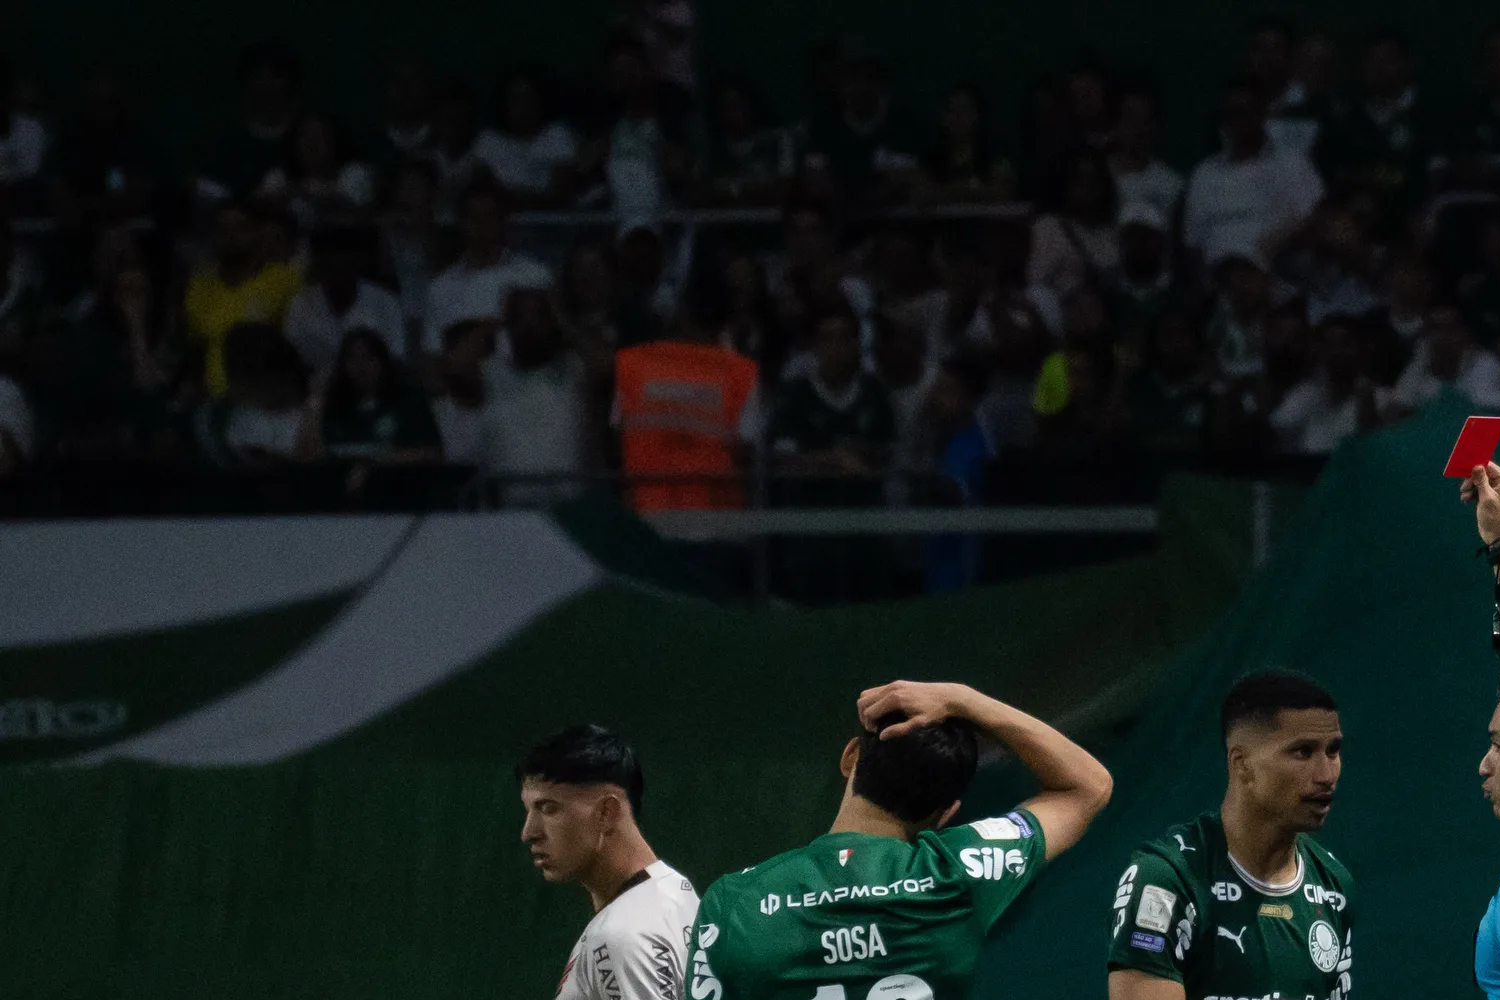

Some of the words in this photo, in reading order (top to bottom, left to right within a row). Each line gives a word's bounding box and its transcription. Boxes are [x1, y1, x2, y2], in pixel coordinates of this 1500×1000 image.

[786, 876, 935, 908] LEAPMOTOR
[1211, 882, 1242, 901] ED
[820, 923, 888, 964] SOSA
